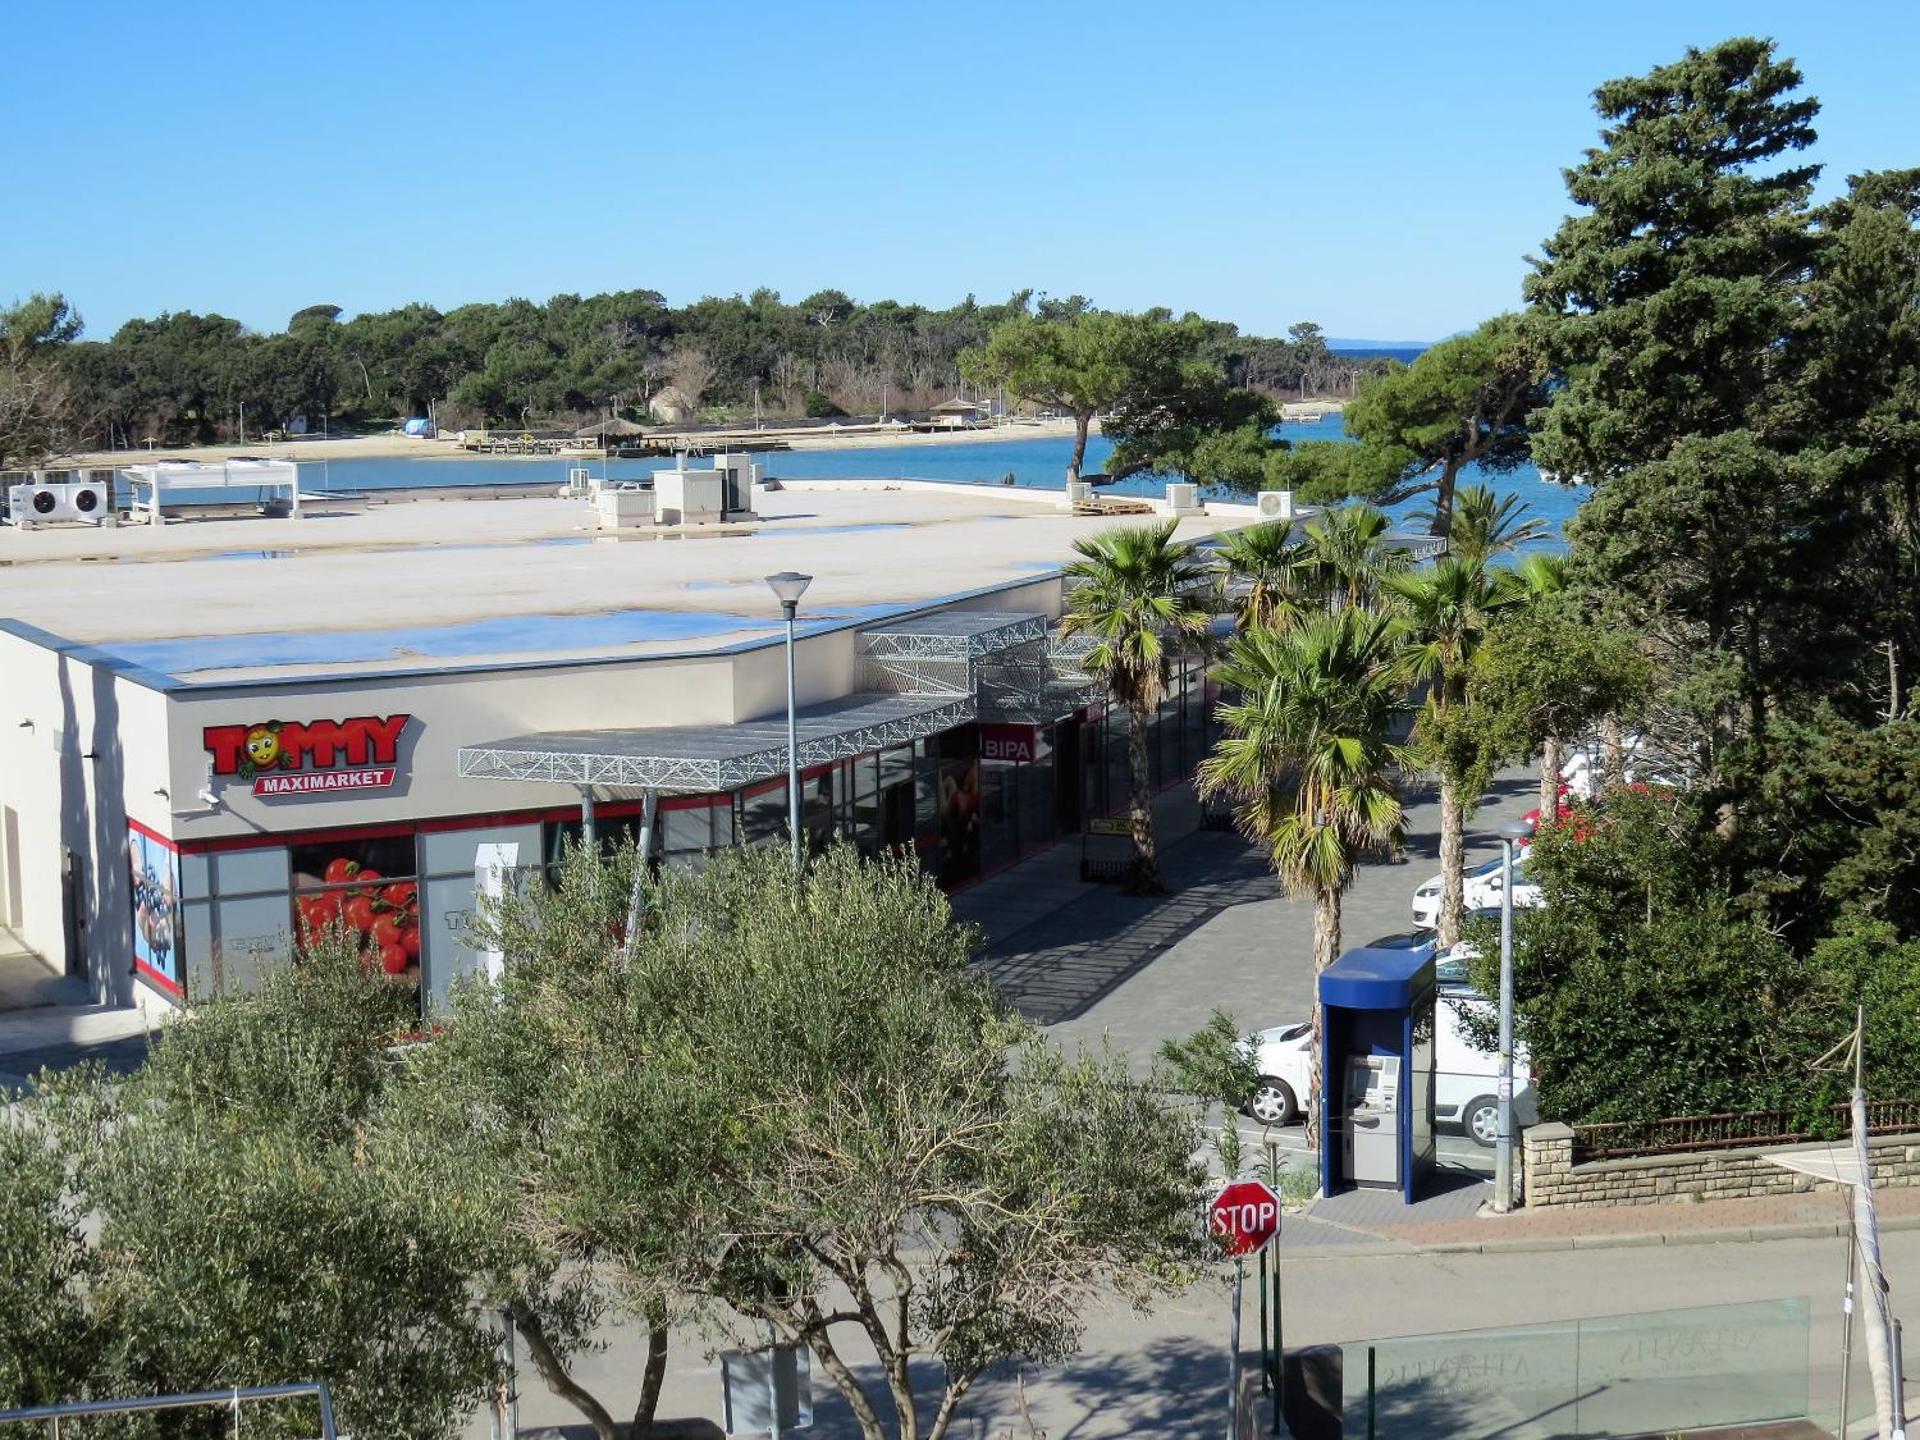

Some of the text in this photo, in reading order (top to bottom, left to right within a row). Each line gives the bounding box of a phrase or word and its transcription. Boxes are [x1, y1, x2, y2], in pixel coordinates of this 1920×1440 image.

[203, 714, 411, 776] TOMMY
[985, 740, 1030, 759] BIPA
[263, 771, 385, 793] MAXIMARKET
[1214, 1202, 1275, 1238] STOP
